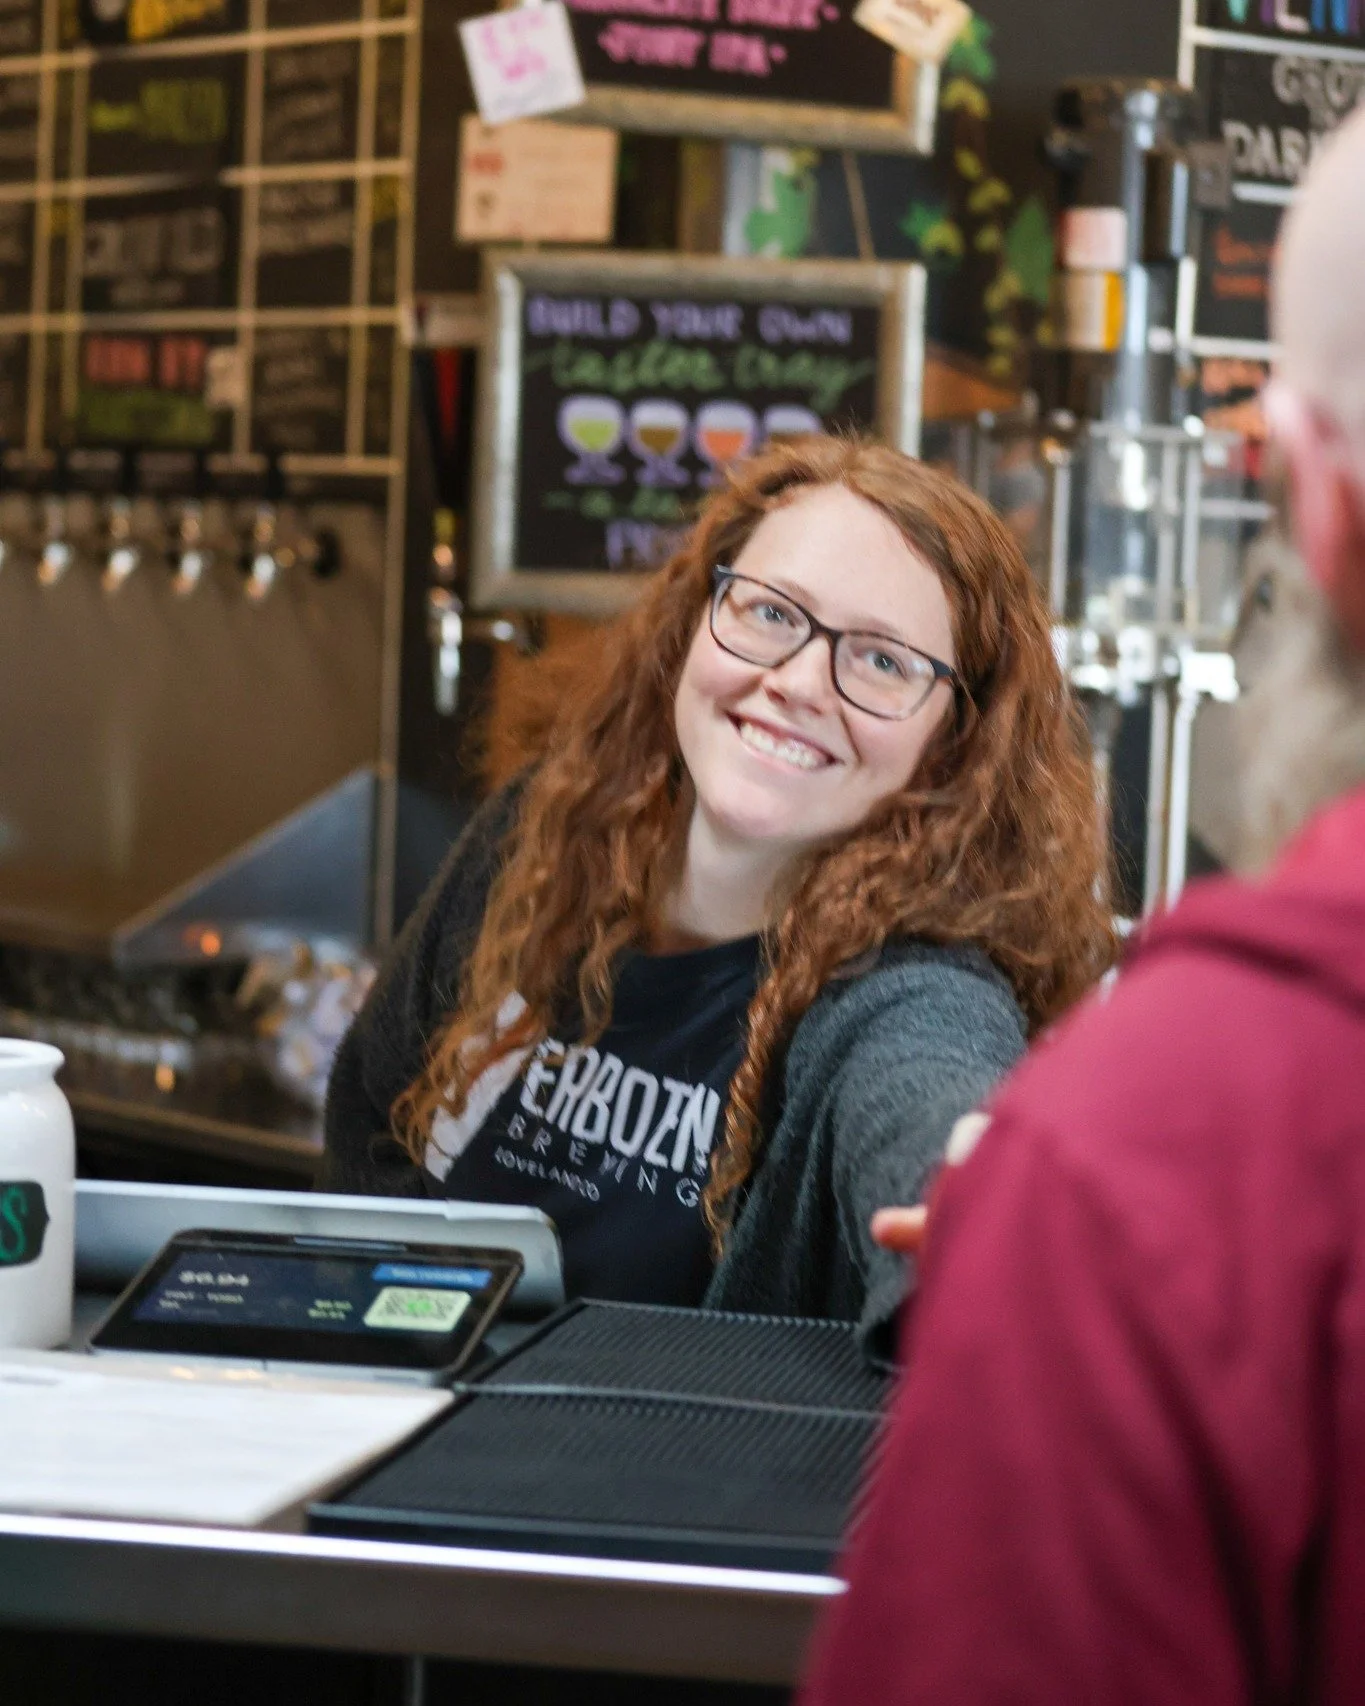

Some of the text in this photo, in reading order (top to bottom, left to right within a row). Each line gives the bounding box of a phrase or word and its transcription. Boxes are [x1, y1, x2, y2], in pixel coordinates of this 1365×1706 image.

[1220, 120, 1320, 179] DAR
[527, 297, 853, 345] BUILD YOUR OWN
[507, 1112, 700, 1208] BREWING
